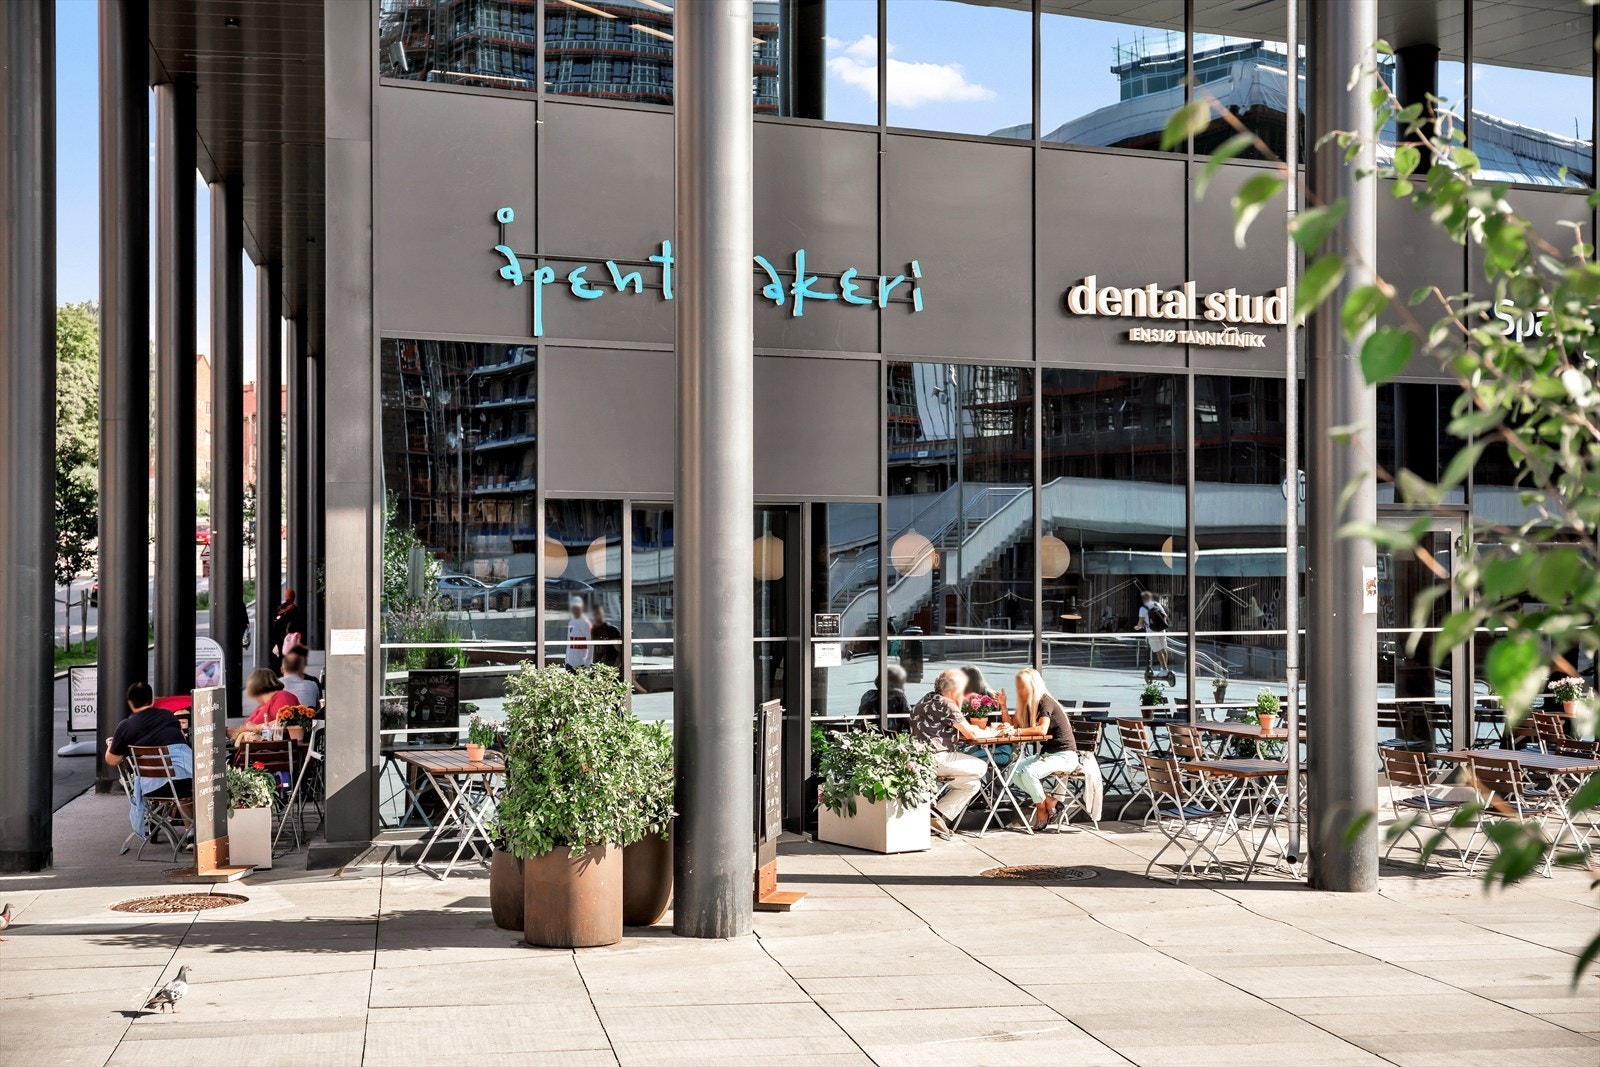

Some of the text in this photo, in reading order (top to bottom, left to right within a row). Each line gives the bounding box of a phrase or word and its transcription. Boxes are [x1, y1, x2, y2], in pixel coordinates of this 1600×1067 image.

[495, 207, 924, 337] åpent akeri
[1067, 274, 1289, 326] dental stud
[1493, 298, 1550, 343] Spa
[1129, 326, 1267, 348] ENSJØ TANNKLINIKK
[74, 705, 96, 714] 650,
